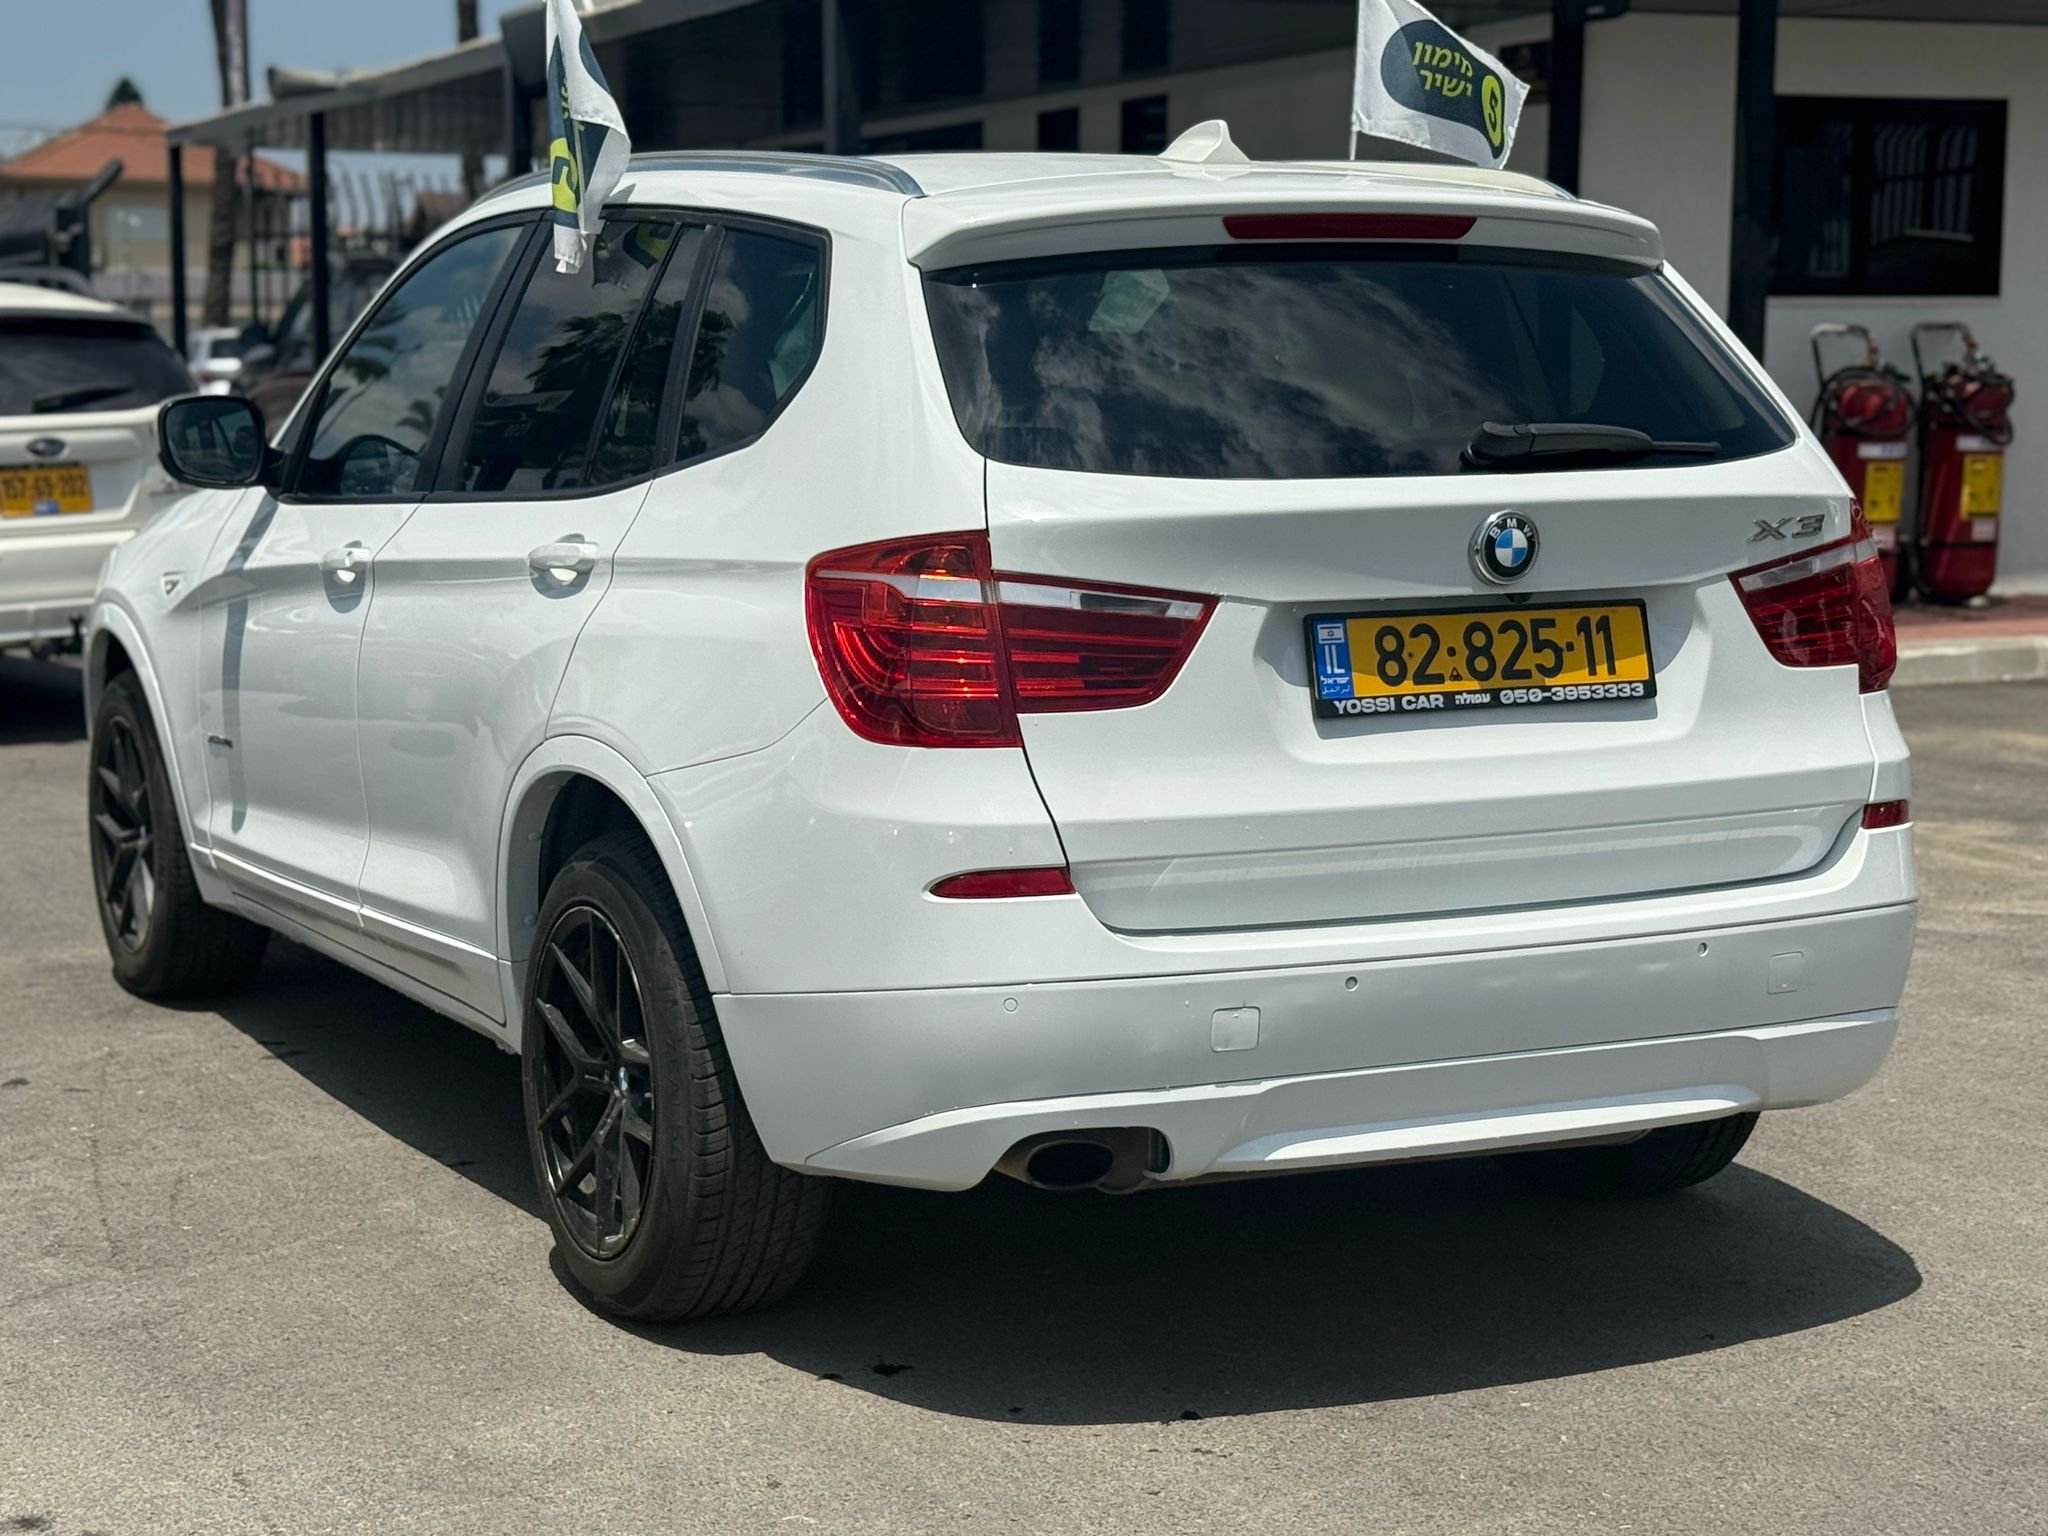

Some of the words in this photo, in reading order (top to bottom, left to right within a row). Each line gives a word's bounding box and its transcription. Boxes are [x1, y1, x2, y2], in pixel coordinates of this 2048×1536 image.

[1412, 41, 1473, 77] מימון
[1419, 69, 1473, 97] ישיר
[1489, 517, 1533, 540] BMW
[1745, 514, 1825, 544] X3
[1324, 644, 1346, 674] IL
[1333, 696, 1396, 714] YOSSI
[1401, 694, 1445, 711] CAR
[1499, 683, 1645, 704] 050-3953333
